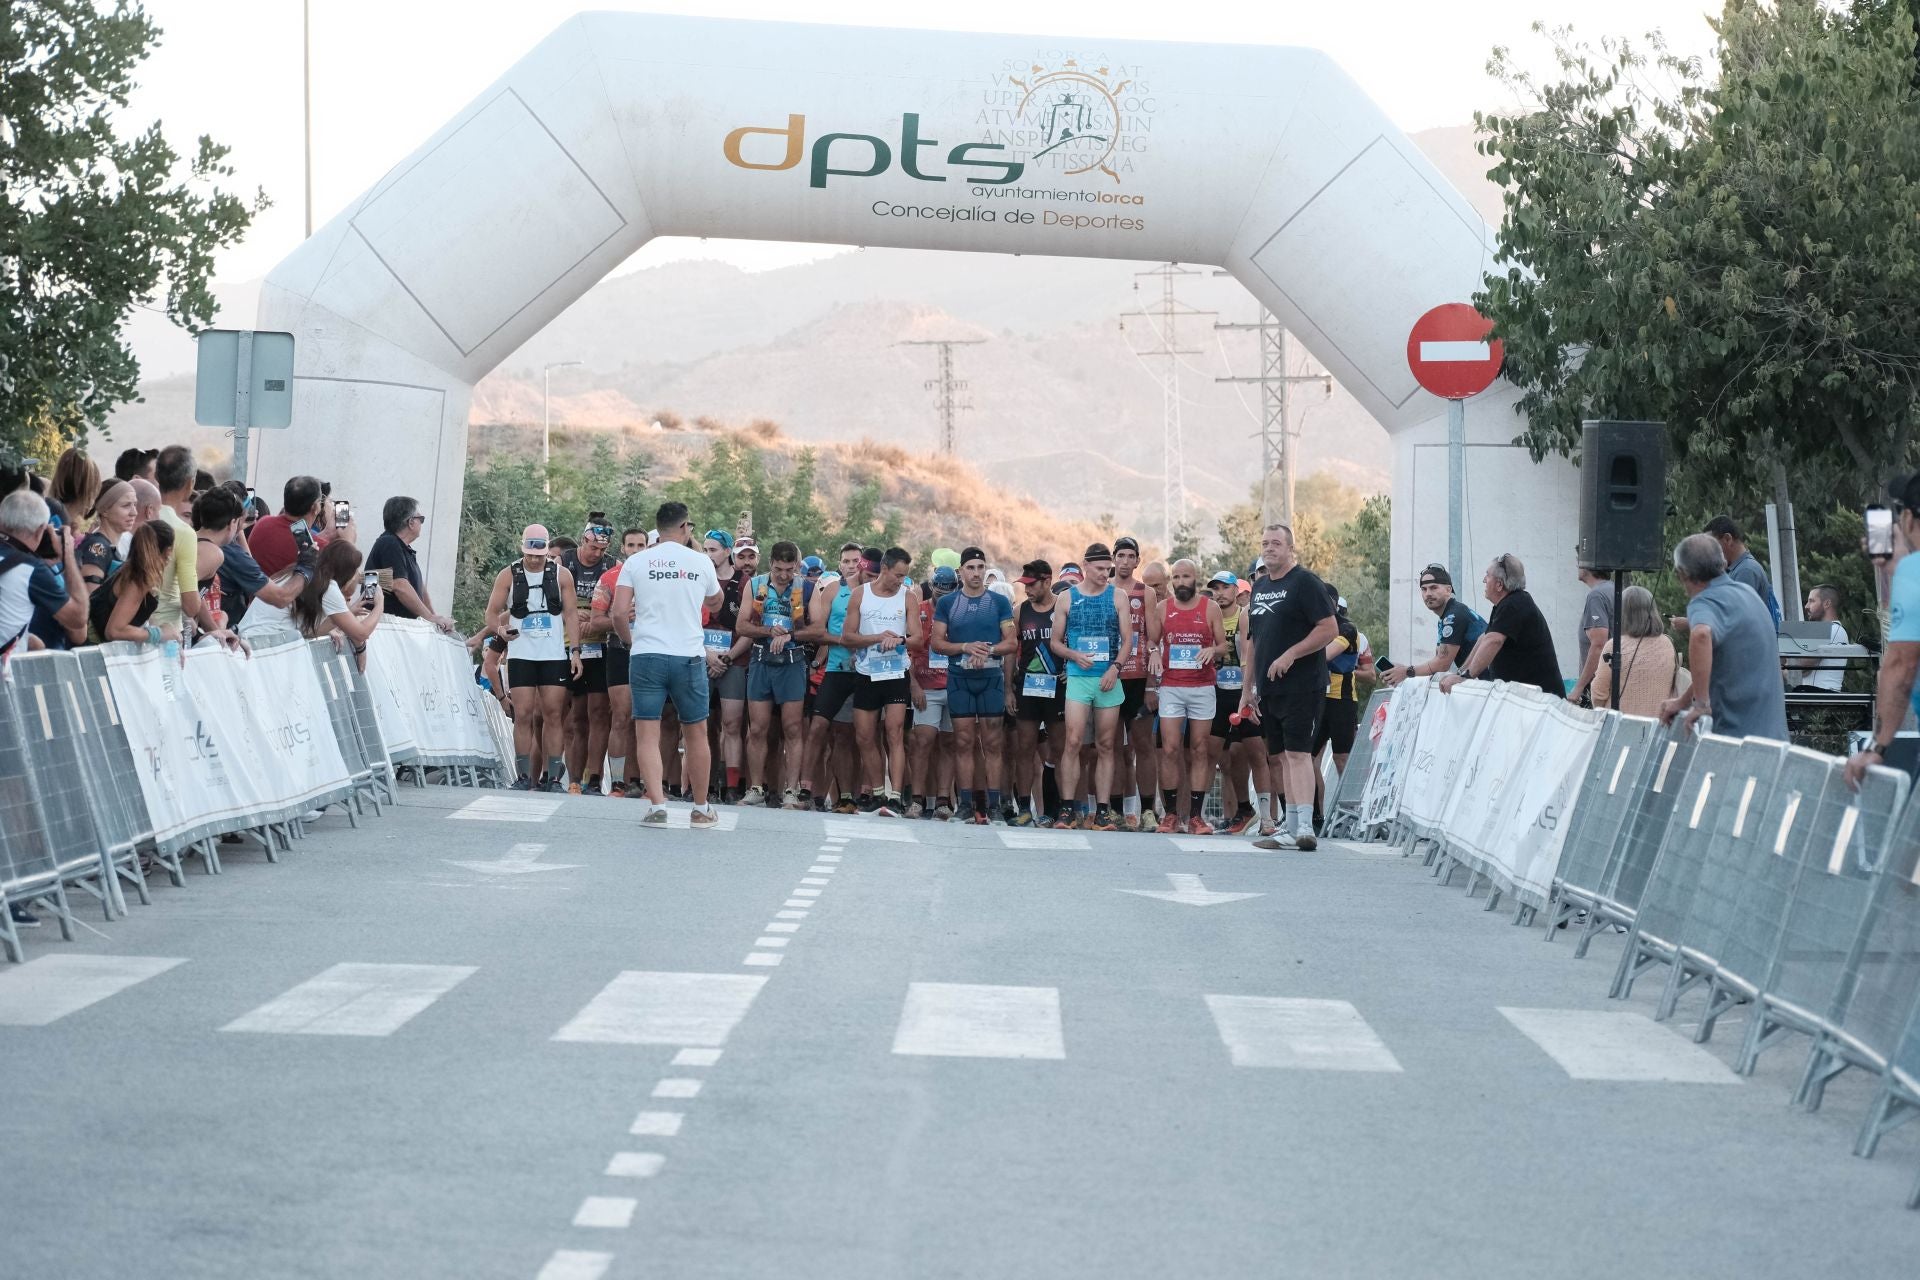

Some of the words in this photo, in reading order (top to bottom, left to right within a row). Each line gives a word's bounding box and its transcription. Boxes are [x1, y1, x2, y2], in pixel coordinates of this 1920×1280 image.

[723, 112, 1025, 189] dpts
[972, 185, 1145, 206] ayuntamientolorca
[872, 201, 996, 223] Concejalía
[1004, 208, 1035, 225] de
[1043, 210, 1145, 231] Deportes
[648, 559, 676, 568] Kike
[648, 570, 700, 581] Speaker
[1254, 590, 1288, 602] Reebok
[532, 617, 542, 626] 45
[772, 618, 783, 626] 64
[708, 634, 723, 643] 102
[1087, 641, 1098, 650] 35
[1180, 649, 1191, 658] 69
[880, 660, 892, 670] 74
[1226, 671, 1237, 679] 93
[1034, 678, 1046, 686] 98
